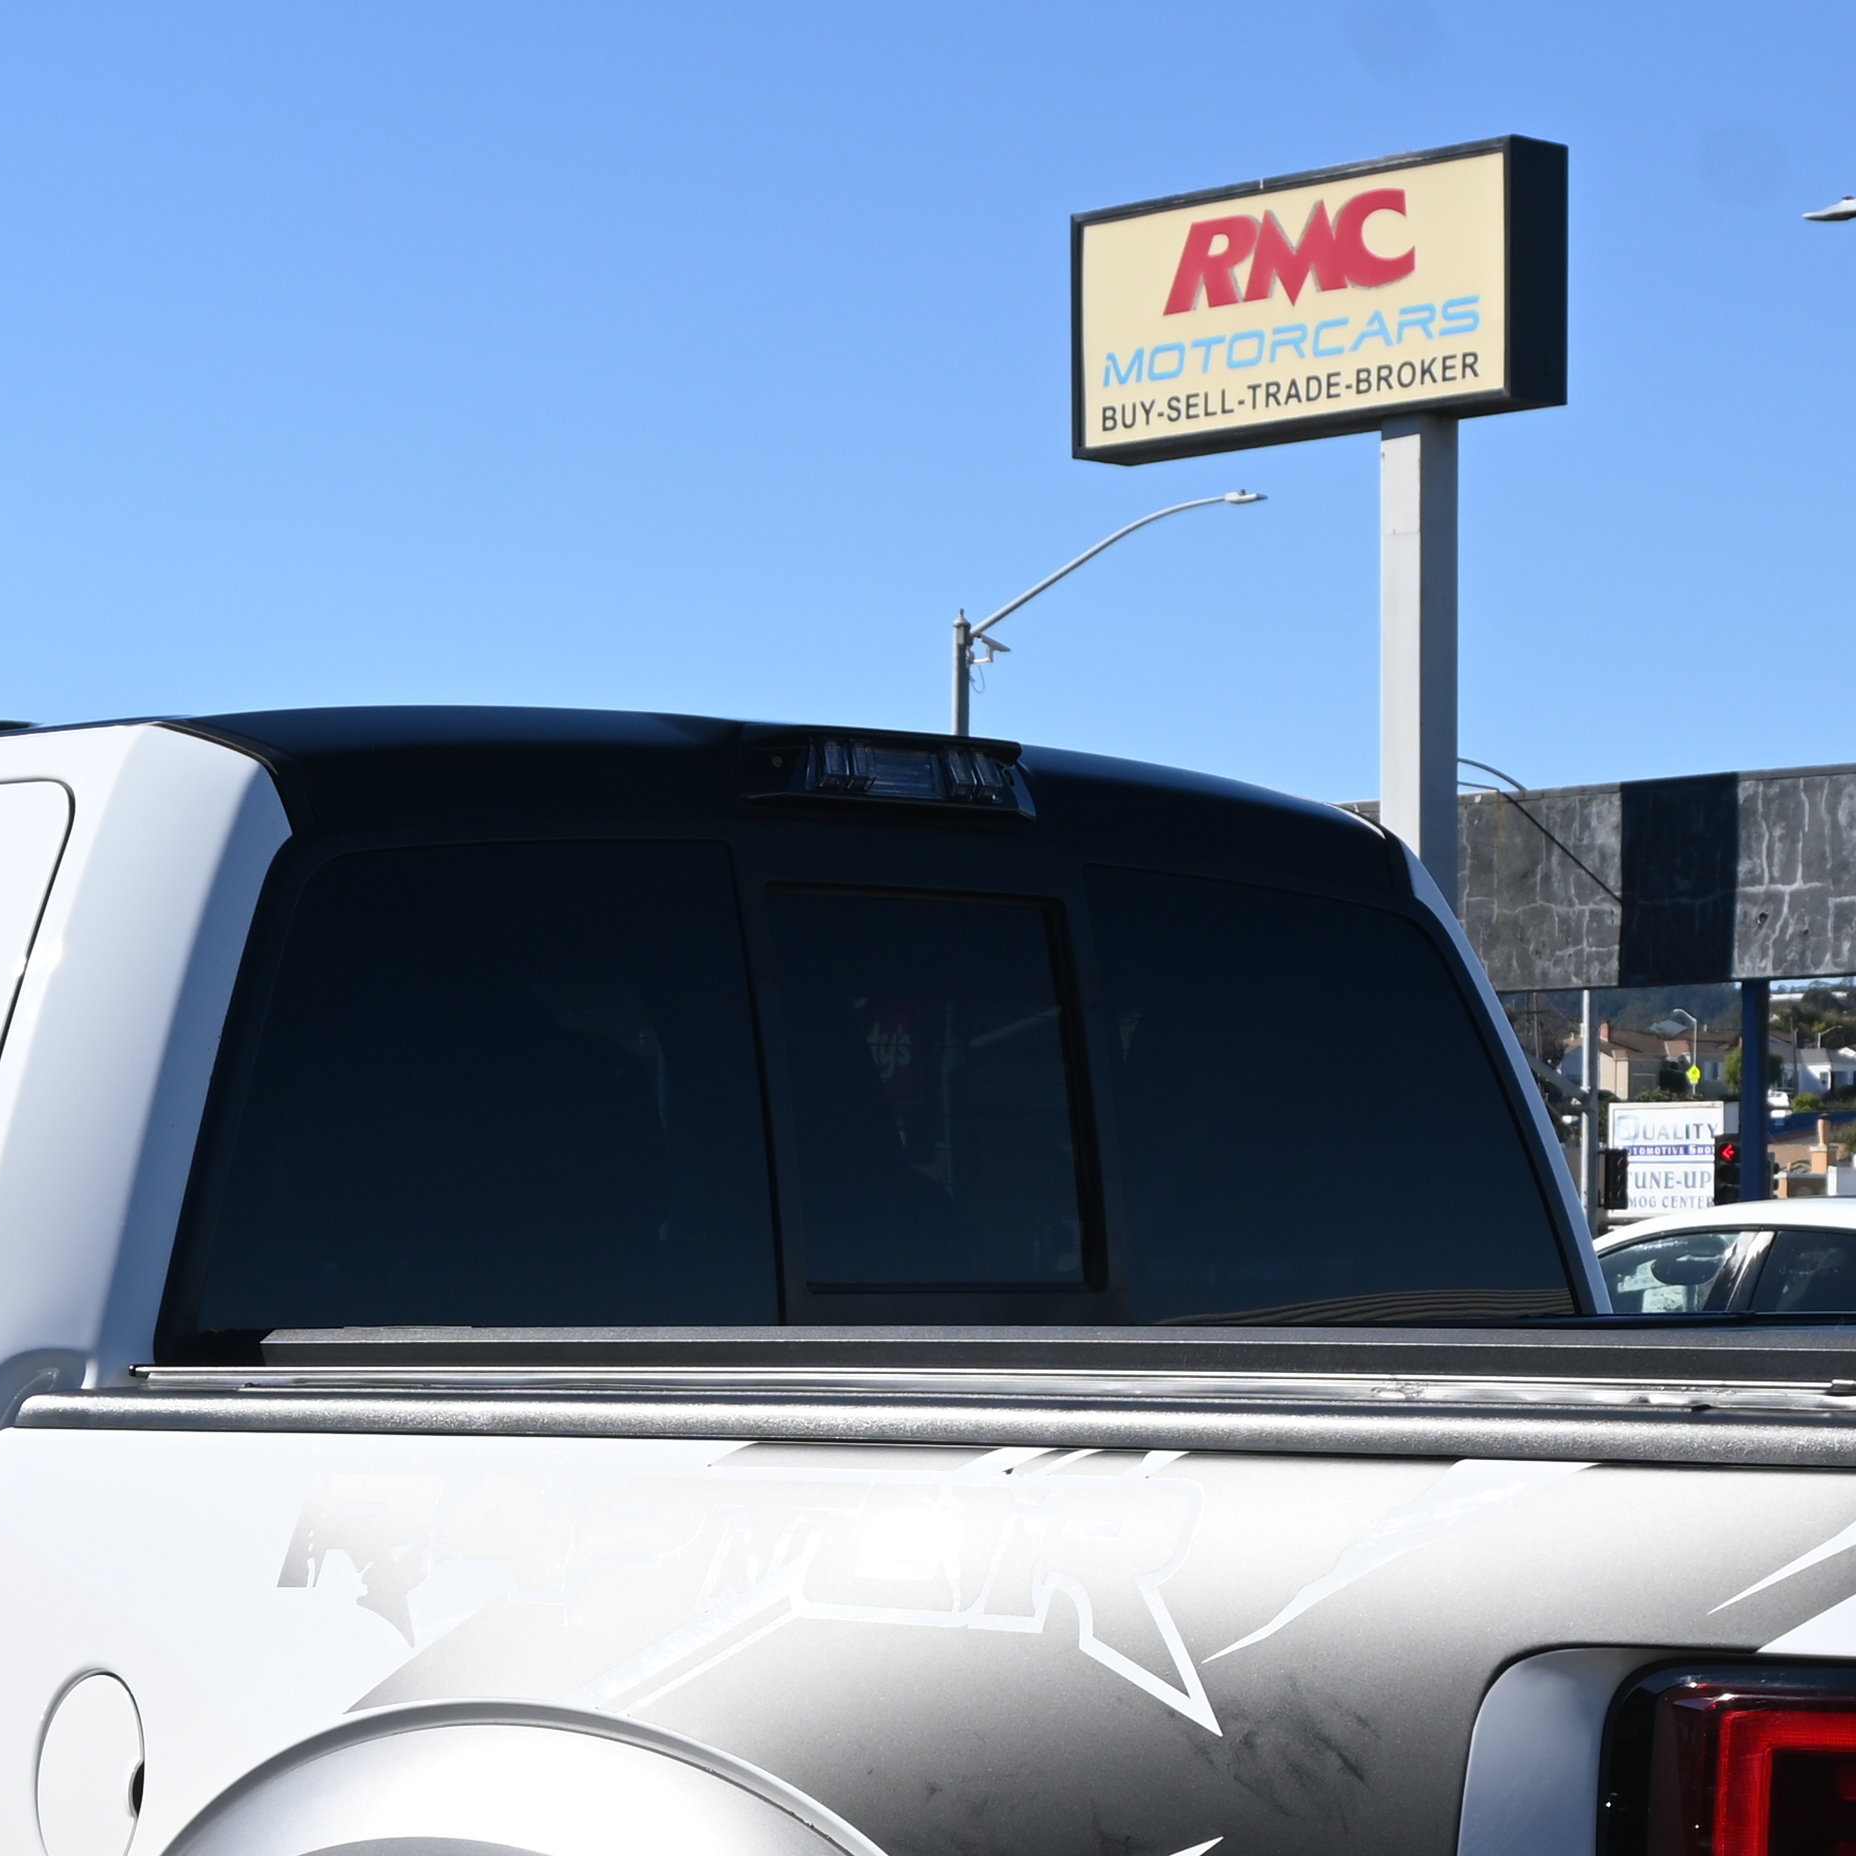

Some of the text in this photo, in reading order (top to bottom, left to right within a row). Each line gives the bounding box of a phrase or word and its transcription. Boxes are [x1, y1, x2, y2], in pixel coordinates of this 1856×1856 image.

[1163, 187, 1416, 316] RMC
[1102, 294, 1481, 387] MOTORCARS
[1101, 351, 1480, 432] BUY-SELL-TRADE-BROKER
[1616, 1114, 1718, 1142] QUALITY
[1620, 1146, 1684, 1156] UTOMOTIVE
[1629, 1170, 1712, 1189] UNE-UP
[1629, 1196, 1657, 1208] MOG
